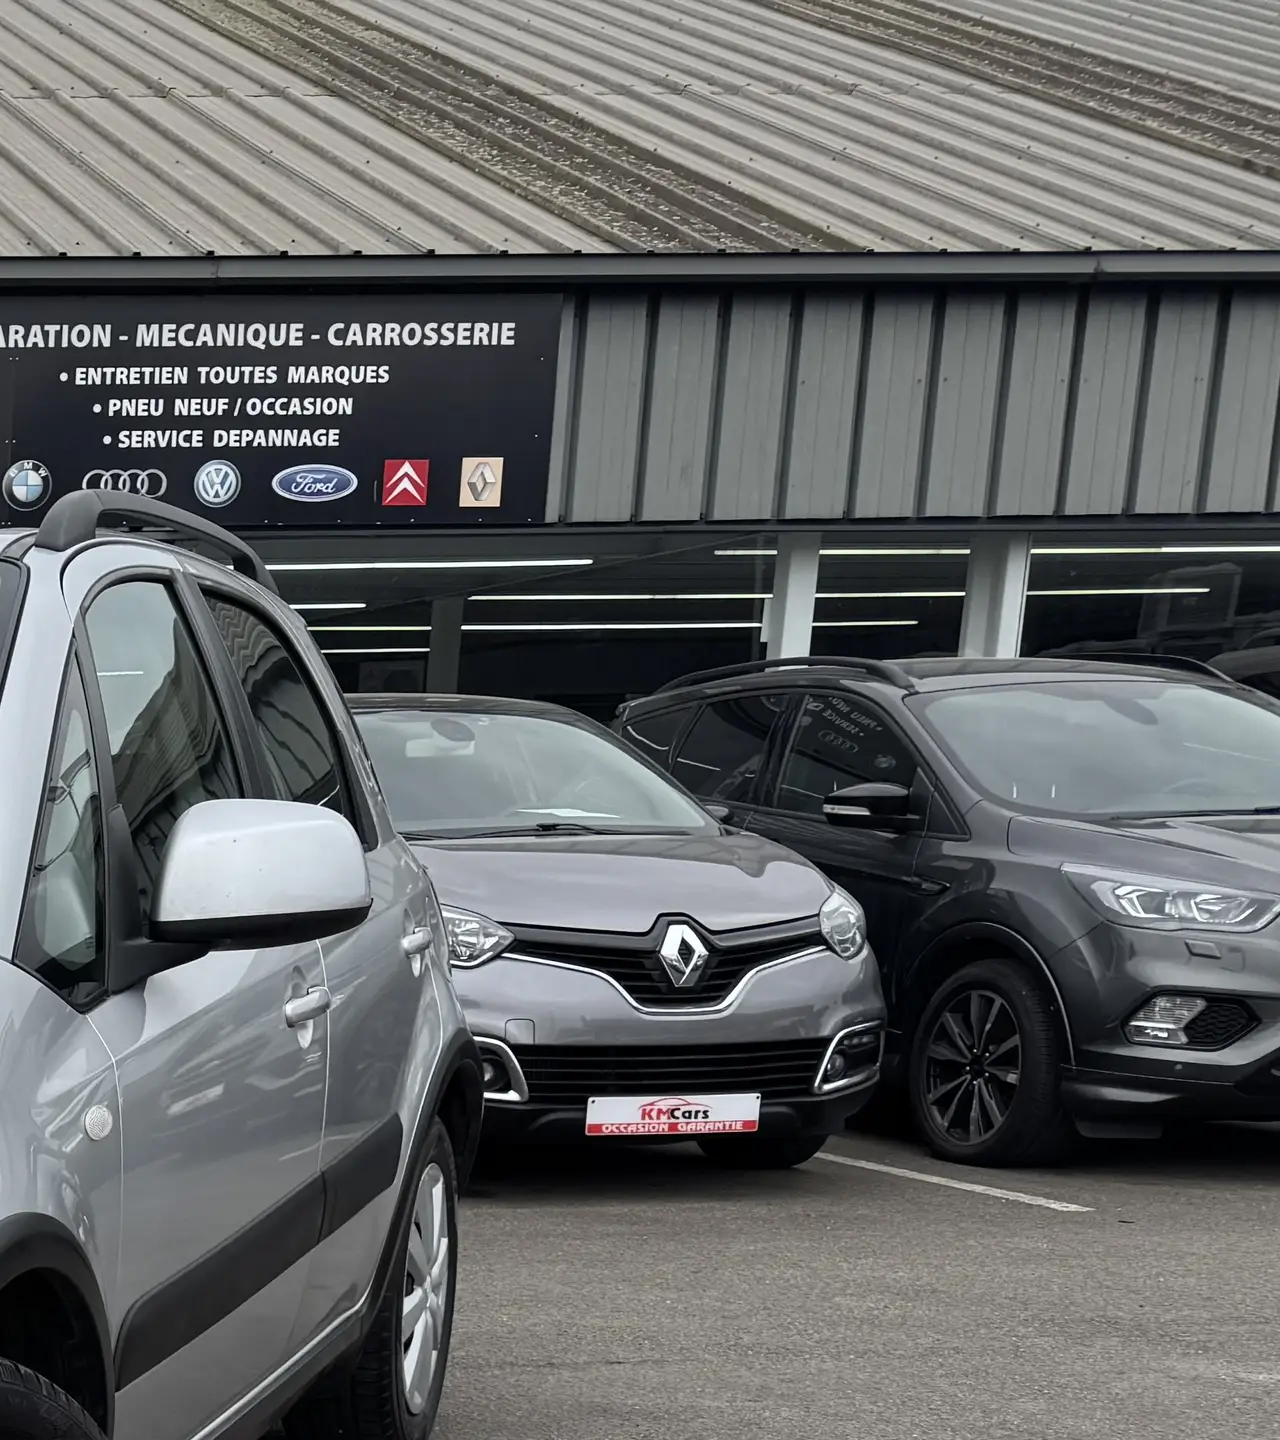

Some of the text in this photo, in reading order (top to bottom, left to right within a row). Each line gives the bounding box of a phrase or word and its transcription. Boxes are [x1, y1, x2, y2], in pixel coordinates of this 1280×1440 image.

[135, 323, 304, 350] MECANIQUE
[327, 322, 516, 347] CARROSSERIE
[75, 365, 390, 386] ENTRETIEN TOUTES MARQUES
[108, 398, 164, 417] PNEU
[117, 428, 340, 449] SERVICE DEPANNAGE
[291, 472, 338, 493] Ford
[641, 1106, 710, 1121] KMCars
[601, 1120, 744, 1134] OCCASION GARANTIE
